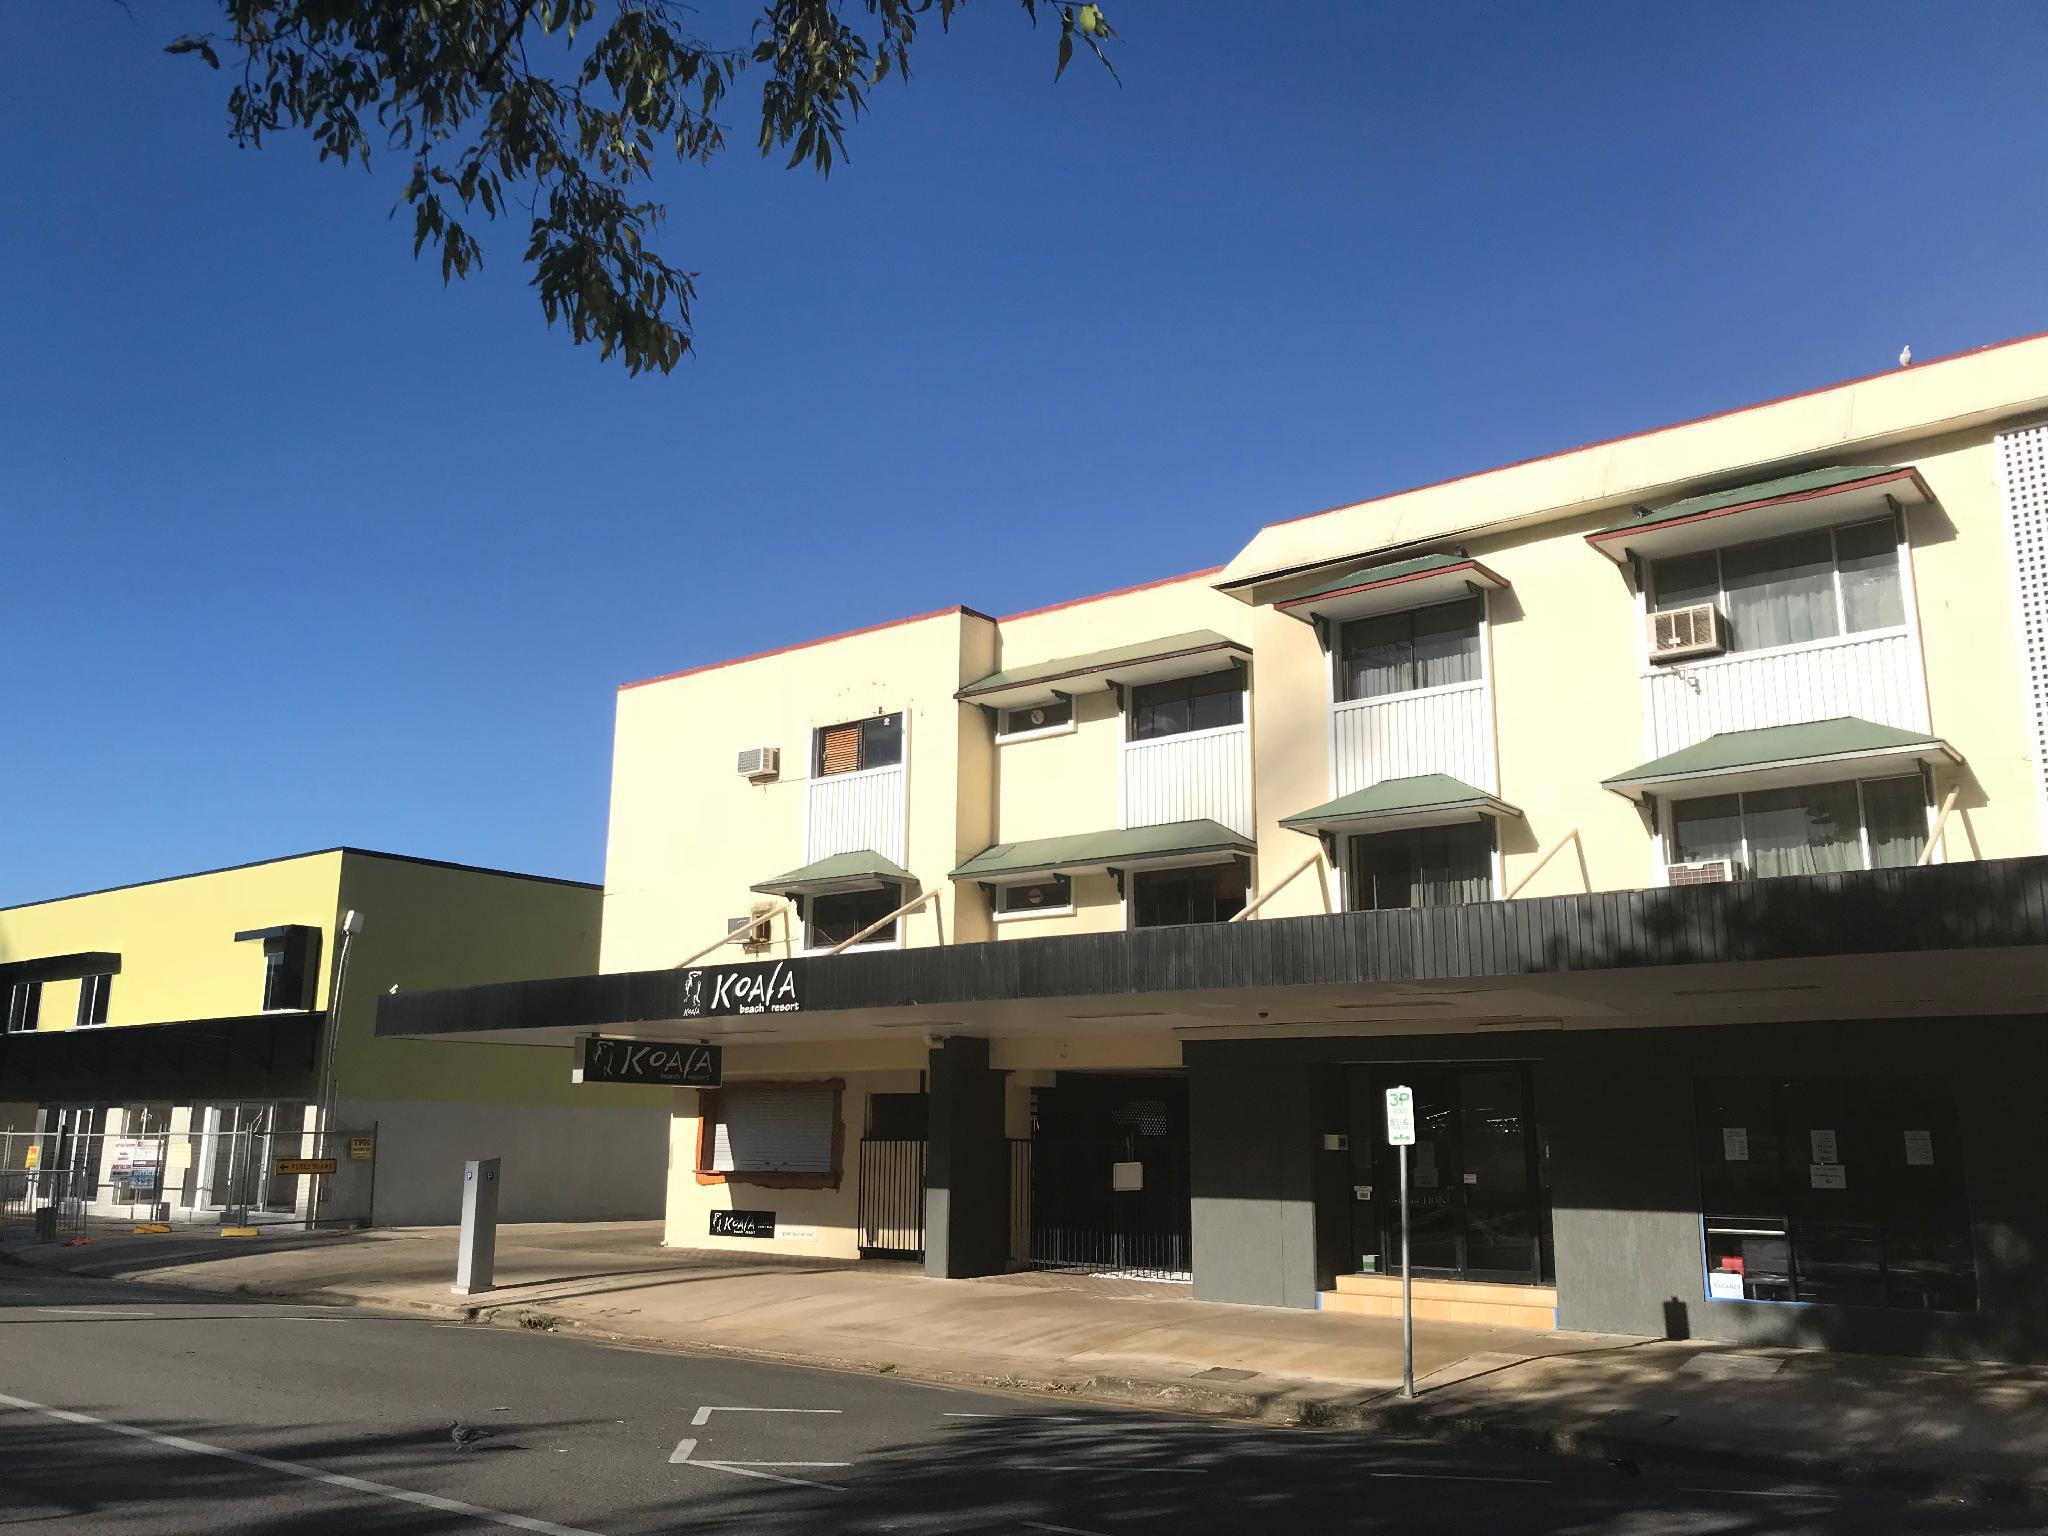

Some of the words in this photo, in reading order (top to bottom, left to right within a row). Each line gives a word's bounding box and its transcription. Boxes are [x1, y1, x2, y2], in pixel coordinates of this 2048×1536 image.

[740, 1003, 765, 1014] beach
[771, 1002, 800, 1012] resort
[1390, 1092, 1410, 1107] 3P
